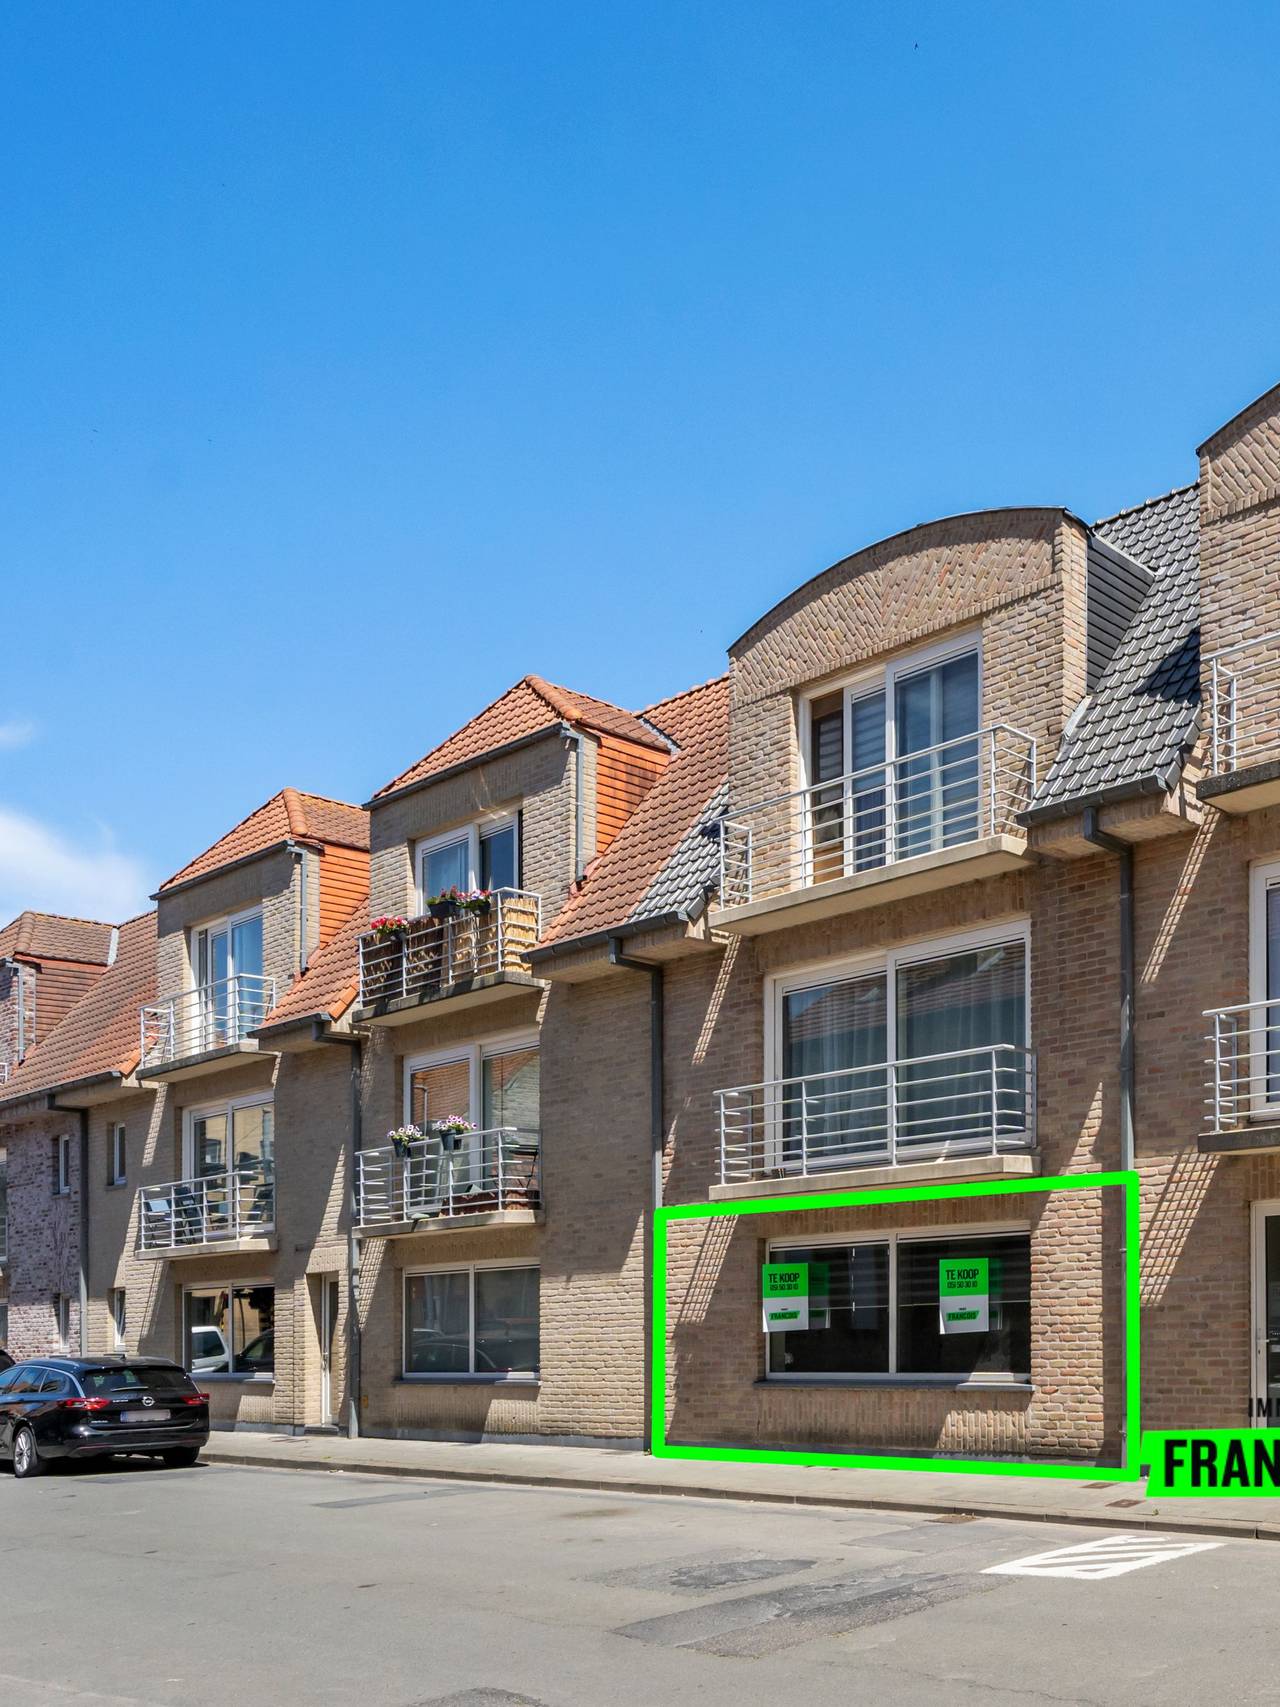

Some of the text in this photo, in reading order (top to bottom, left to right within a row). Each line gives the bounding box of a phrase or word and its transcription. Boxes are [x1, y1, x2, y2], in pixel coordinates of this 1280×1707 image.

[768, 1272, 800, 1283] TE KOOP
[945, 1268, 979, 1280] TE KOOP
